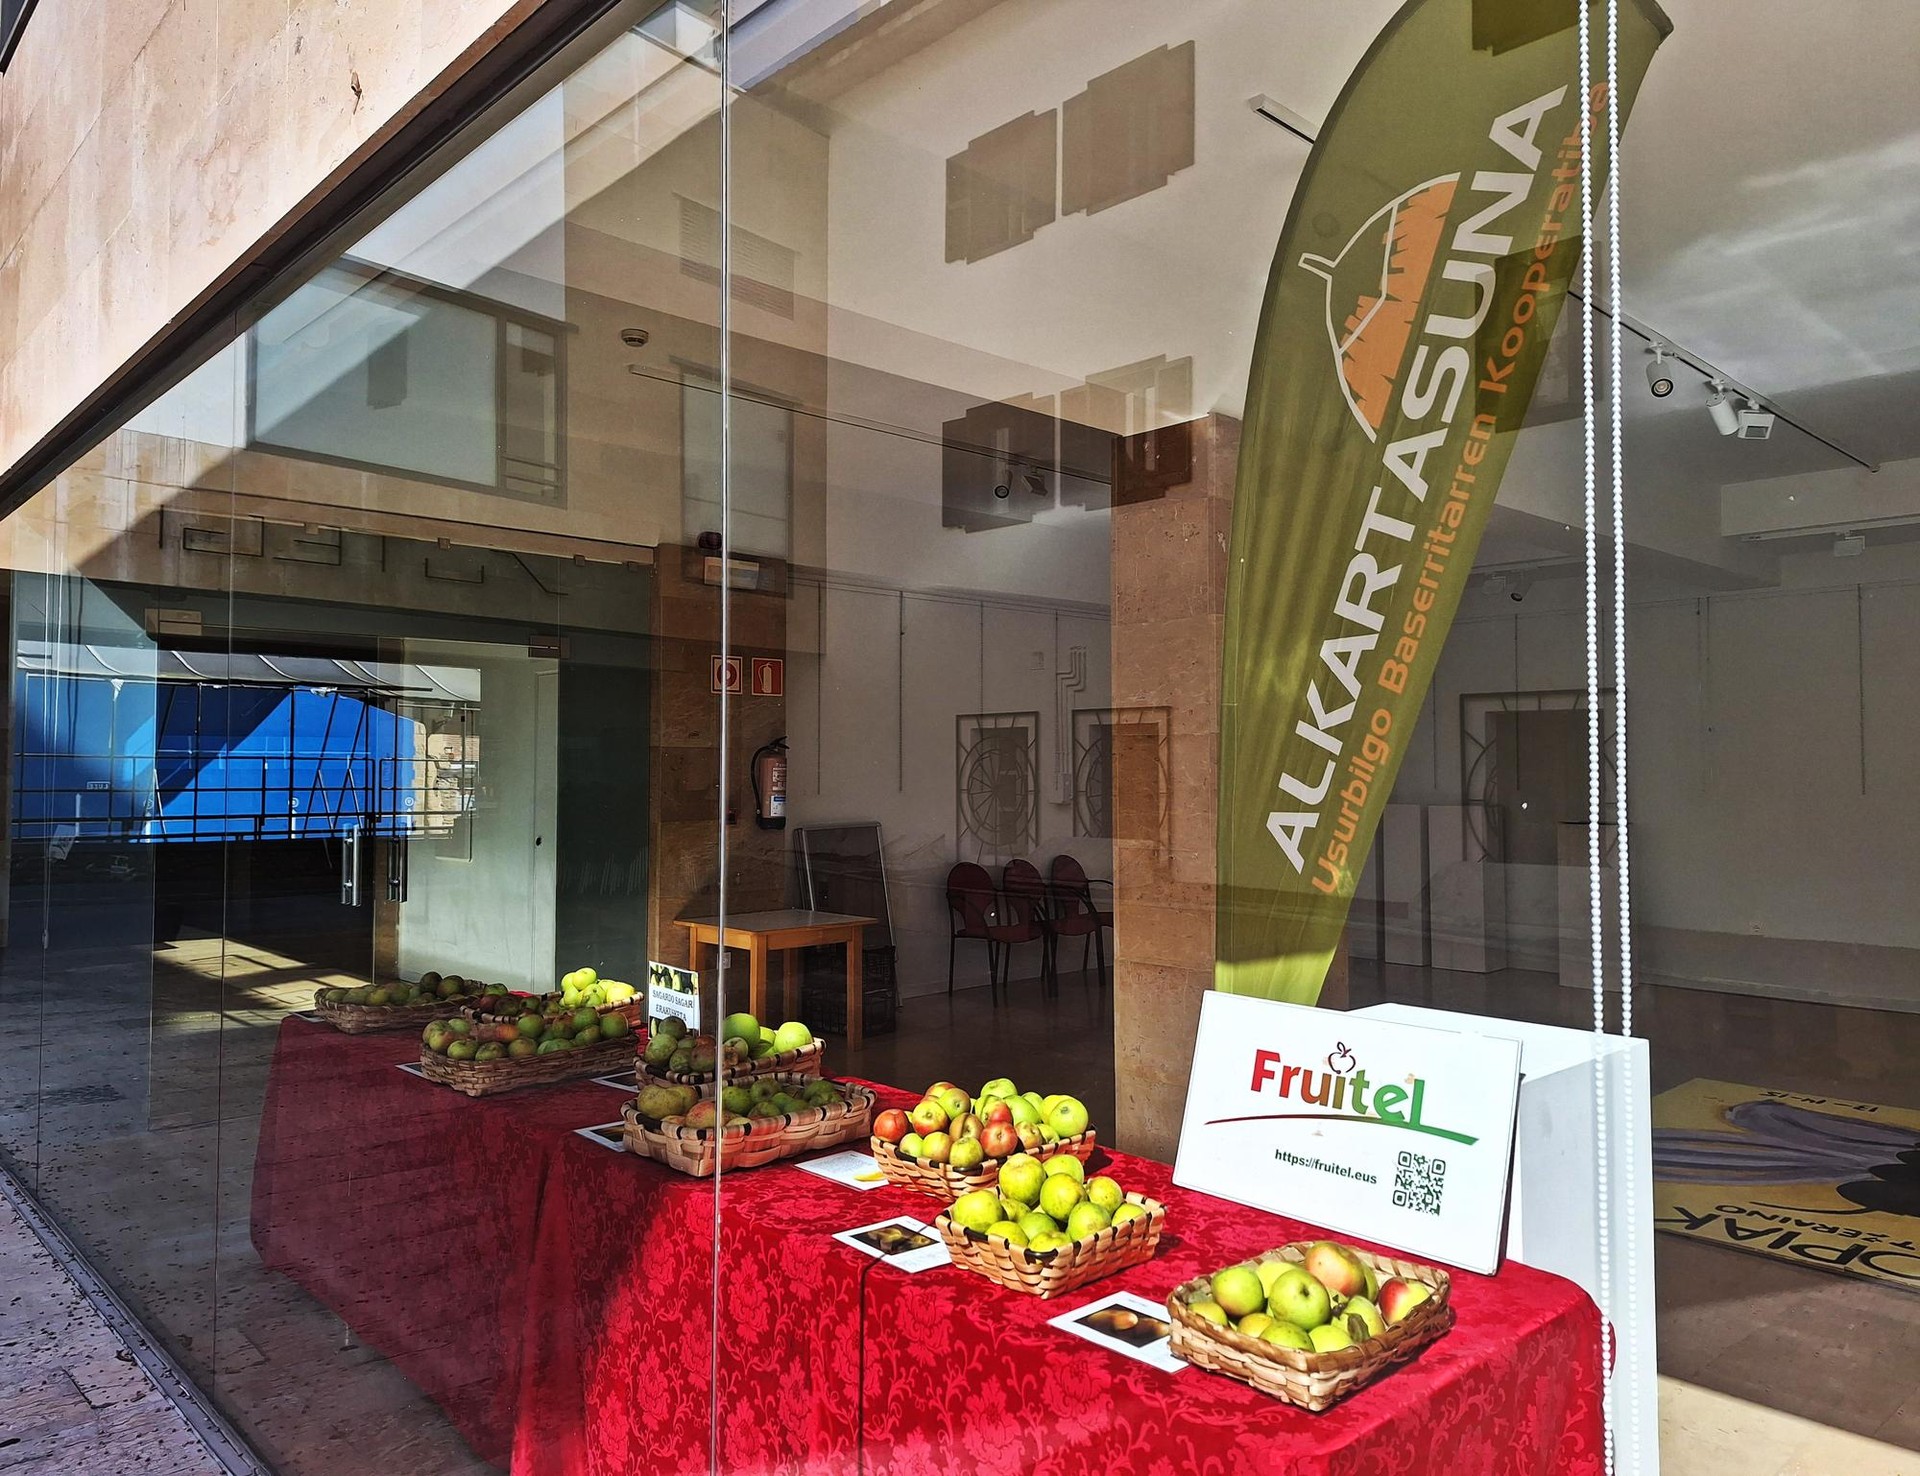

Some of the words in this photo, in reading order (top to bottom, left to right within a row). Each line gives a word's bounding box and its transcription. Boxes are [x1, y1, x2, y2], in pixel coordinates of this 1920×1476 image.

[1266, 84, 1568, 875] ALKARTASUNA
[1311, 707, 1393, 894] Usurbilgo
[1378, 413, 1497, 695] Baserritarren
[1250, 1048, 1426, 1127] Fruitel
[1274, 1148, 1378, 1185] https://fruitel.eus
